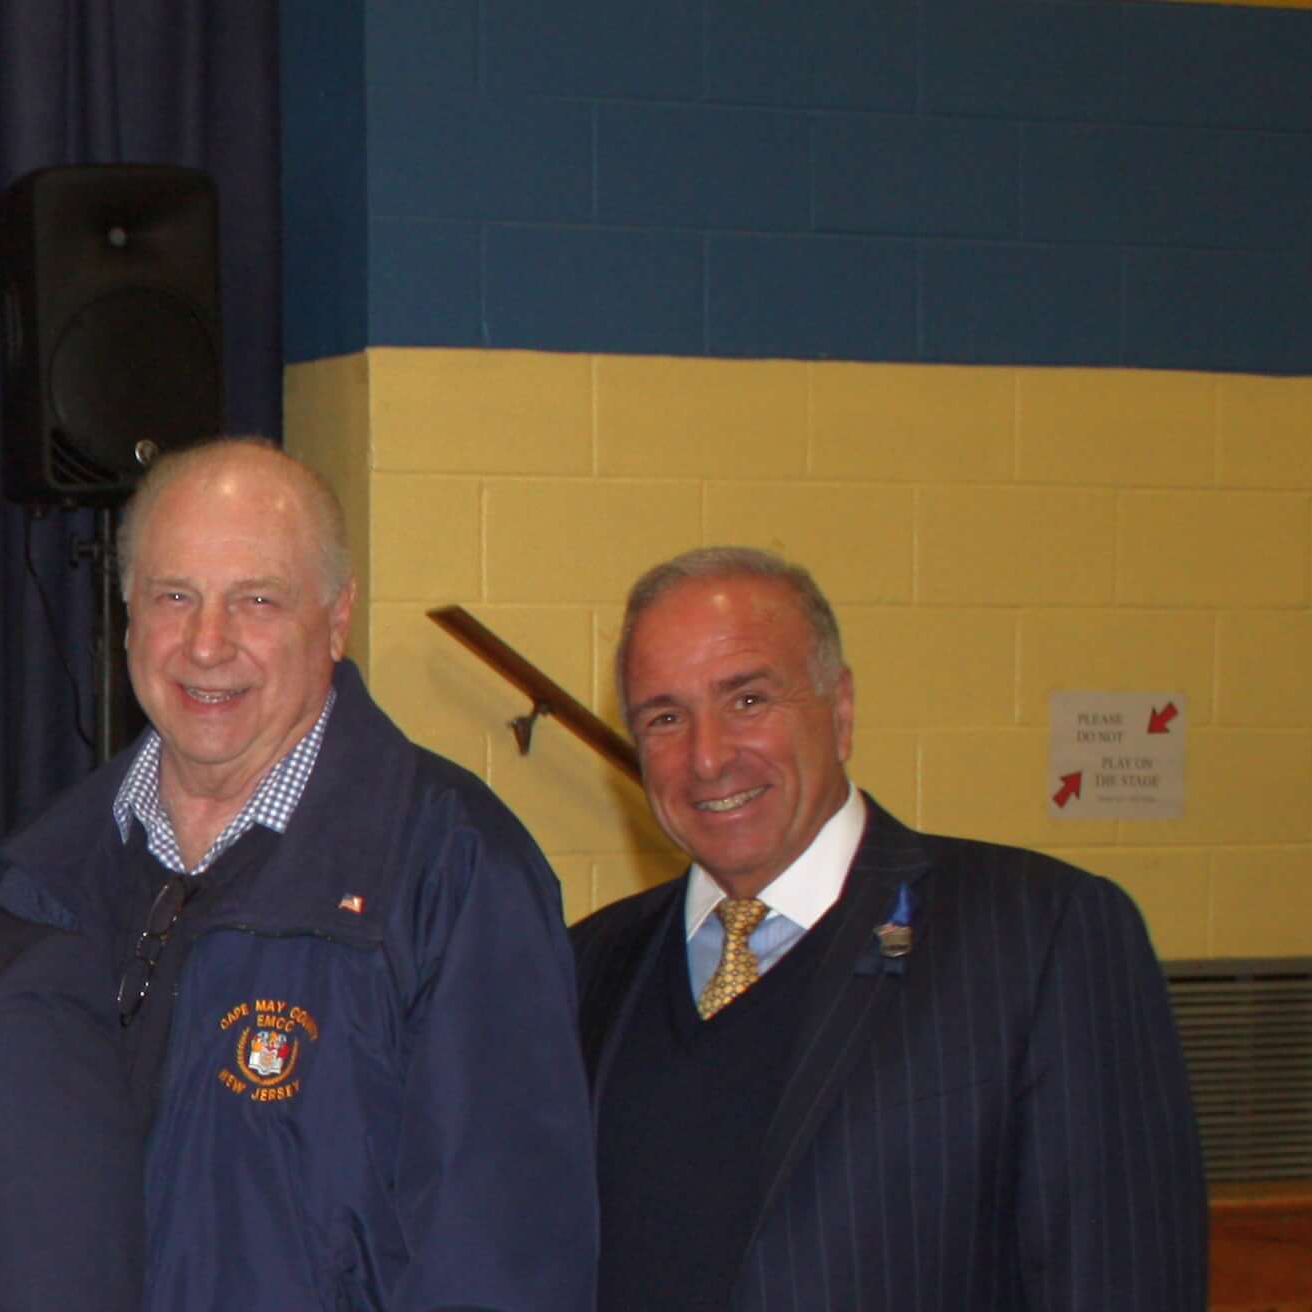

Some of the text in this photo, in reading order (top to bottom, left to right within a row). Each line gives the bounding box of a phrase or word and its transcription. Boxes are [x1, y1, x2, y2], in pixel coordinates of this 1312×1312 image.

[1078, 713, 1122, 725] PLEASE
[1077, 731, 1123, 743] DO NOT
[1102, 757, 1153, 769] PLAY ON
[1096, 775, 1158, 788] THE STAGE
[220, 1002, 251, 1030] CAPE
[255, 999, 287, 1014] MAY
[257, 1013, 295, 1033] EMCC
[218, 1068, 300, 1102] NEW JERSEY
